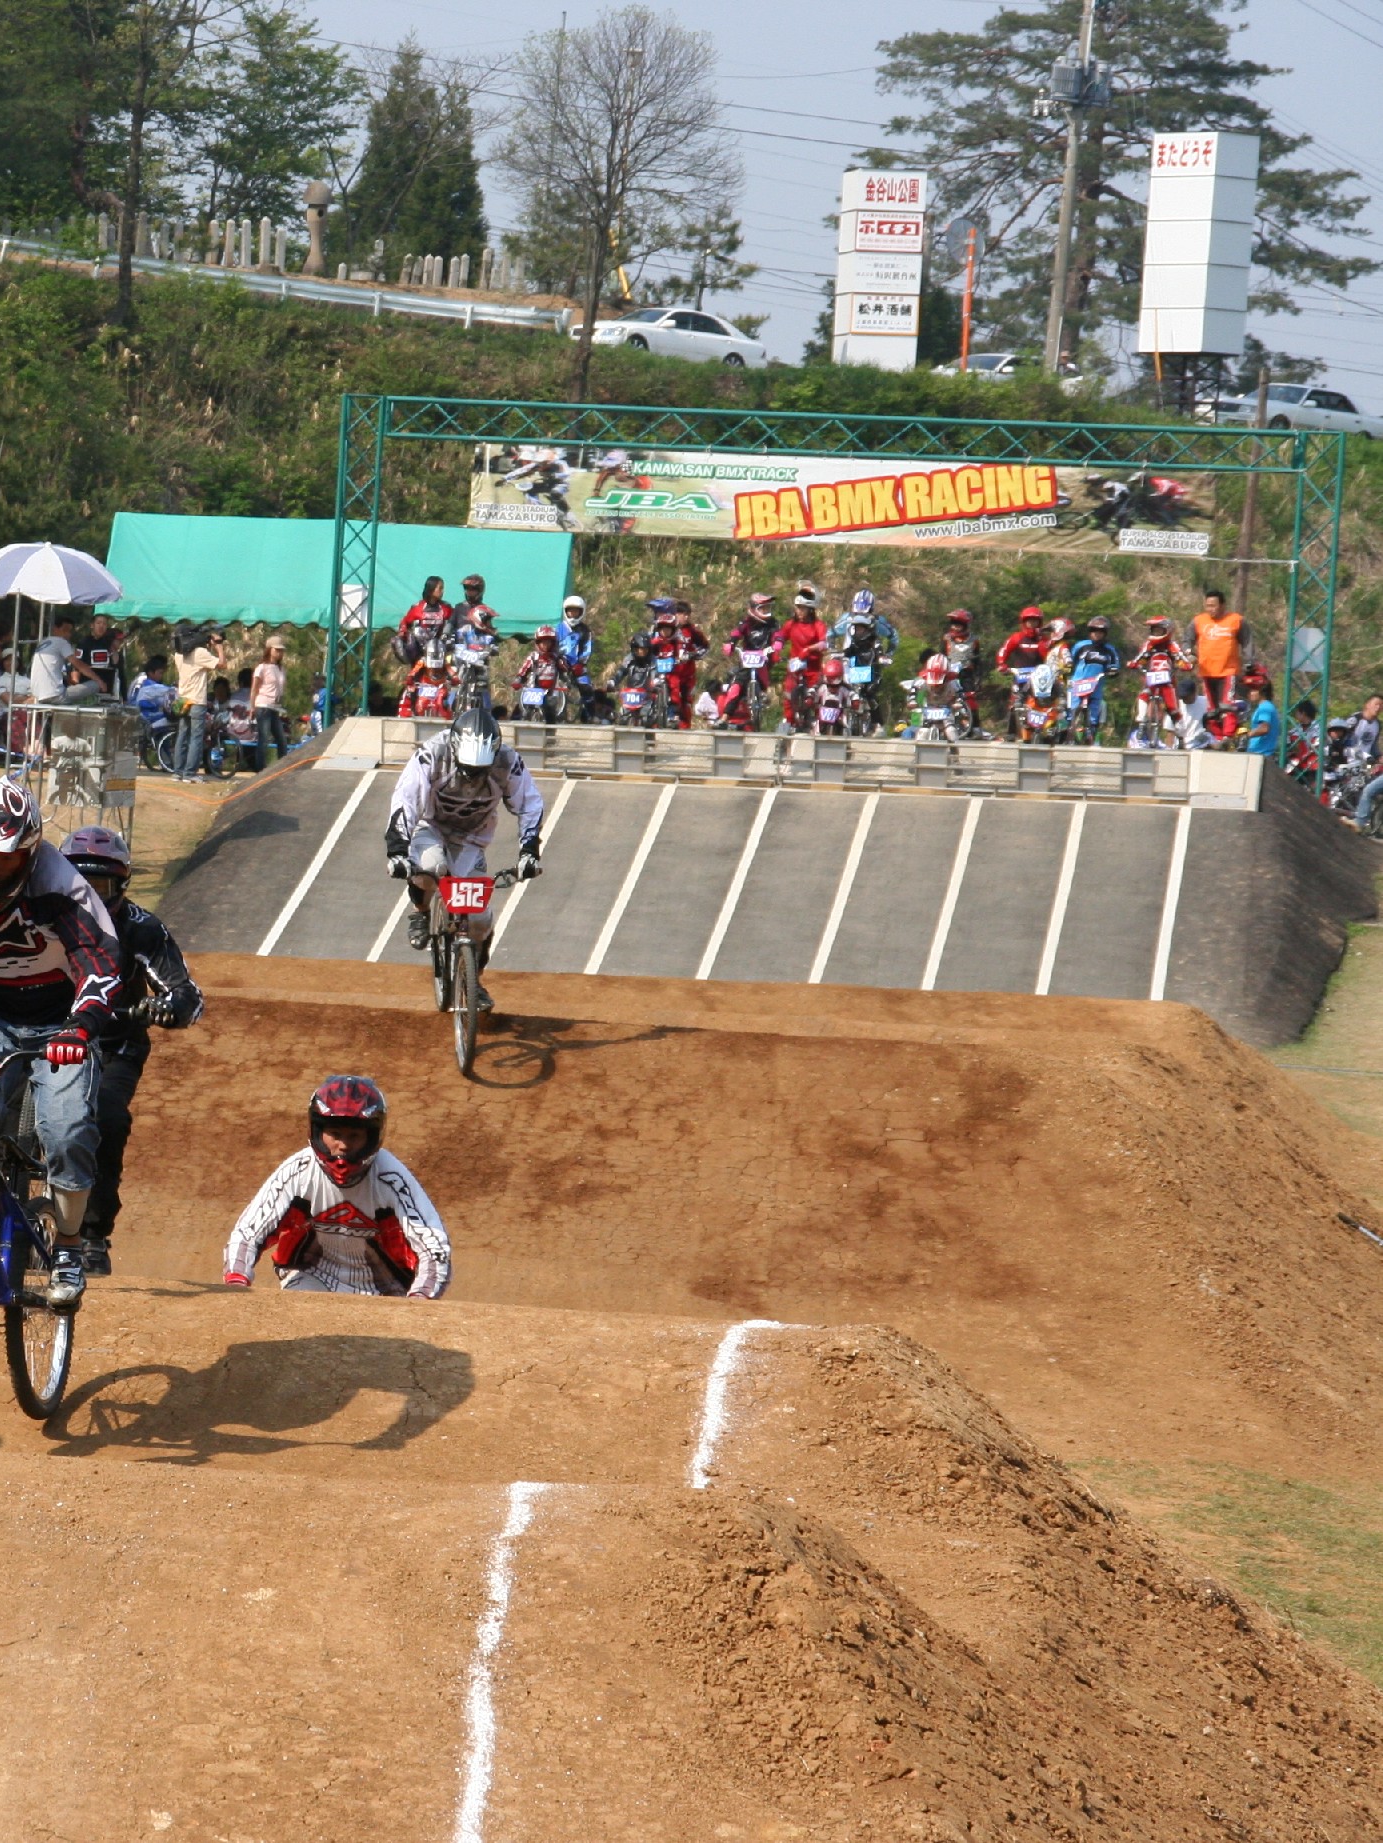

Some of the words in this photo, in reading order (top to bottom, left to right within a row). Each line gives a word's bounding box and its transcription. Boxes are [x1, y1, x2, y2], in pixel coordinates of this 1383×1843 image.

[1157, 139, 1214, 168] またどうぞ
[865, 176, 920, 203] 金谷山公園
[633, 461, 714, 477] KANAYASAN
[715, 465, 748, 479] BMX
[750, 467, 796, 481] TRACK
[522, 505, 556, 513] STADIUM
[585, 491, 717, 512] JBA
[735, 491, 806, 539] JBA
[808, 480, 900, 530] BMX
[901, 465, 1053, 519] RACING
[475, 510, 556, 523] TAMASABURO
[914, 514, 1057, 539] www.jbabmx.com
